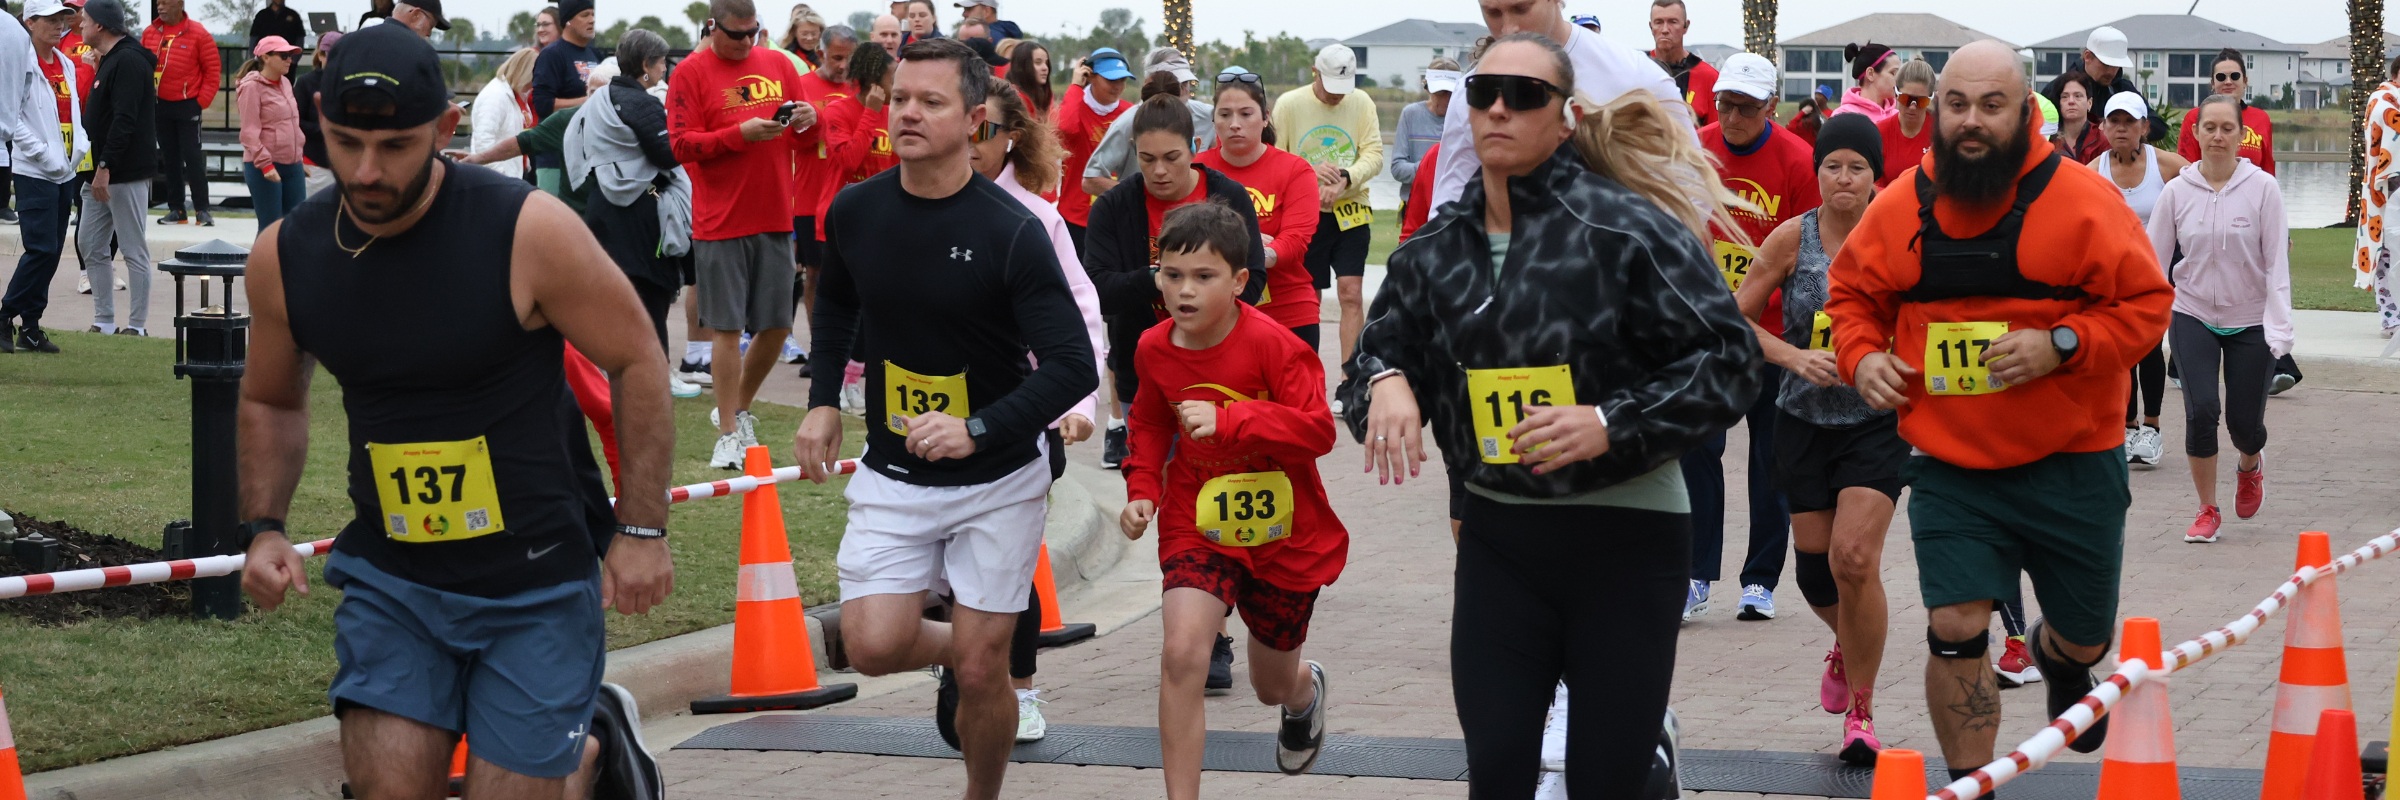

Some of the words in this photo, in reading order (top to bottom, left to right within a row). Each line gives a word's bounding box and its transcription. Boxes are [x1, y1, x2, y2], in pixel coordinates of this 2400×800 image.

[1723, 253, 1754, 275] 12
[1937, 339, 1991, 368] 117
[896, 384, 951, 416] 132
[389, 464, 467, 505] 137
[1213, 489, 1276, 521] 133
